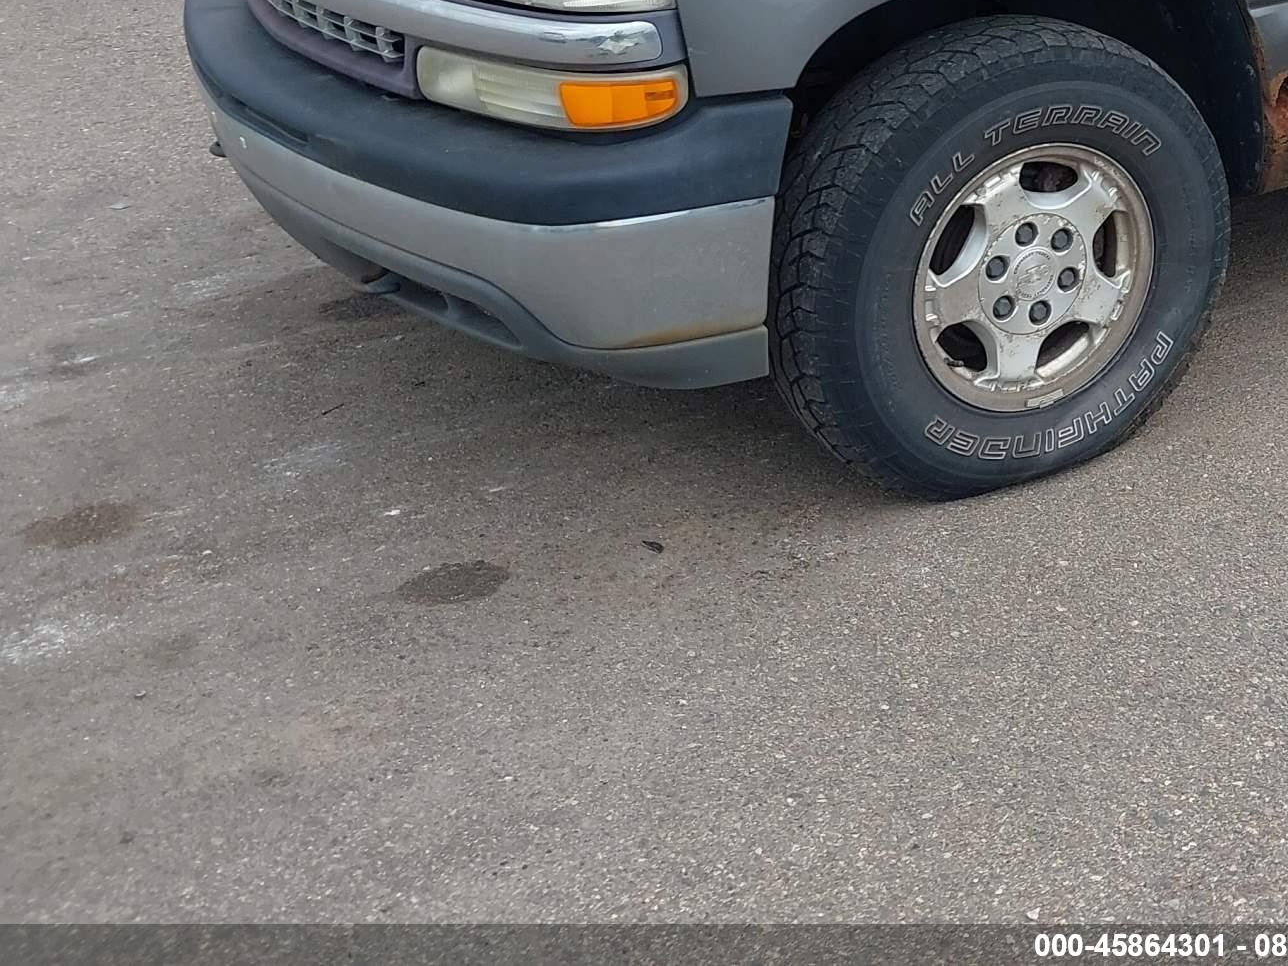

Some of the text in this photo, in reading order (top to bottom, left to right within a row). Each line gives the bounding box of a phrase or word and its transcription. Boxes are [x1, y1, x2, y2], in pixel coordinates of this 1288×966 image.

[909, 104, 1162, 227] ALL TERRAIN
[923, 330, 1175, 461] PATHFINDER
